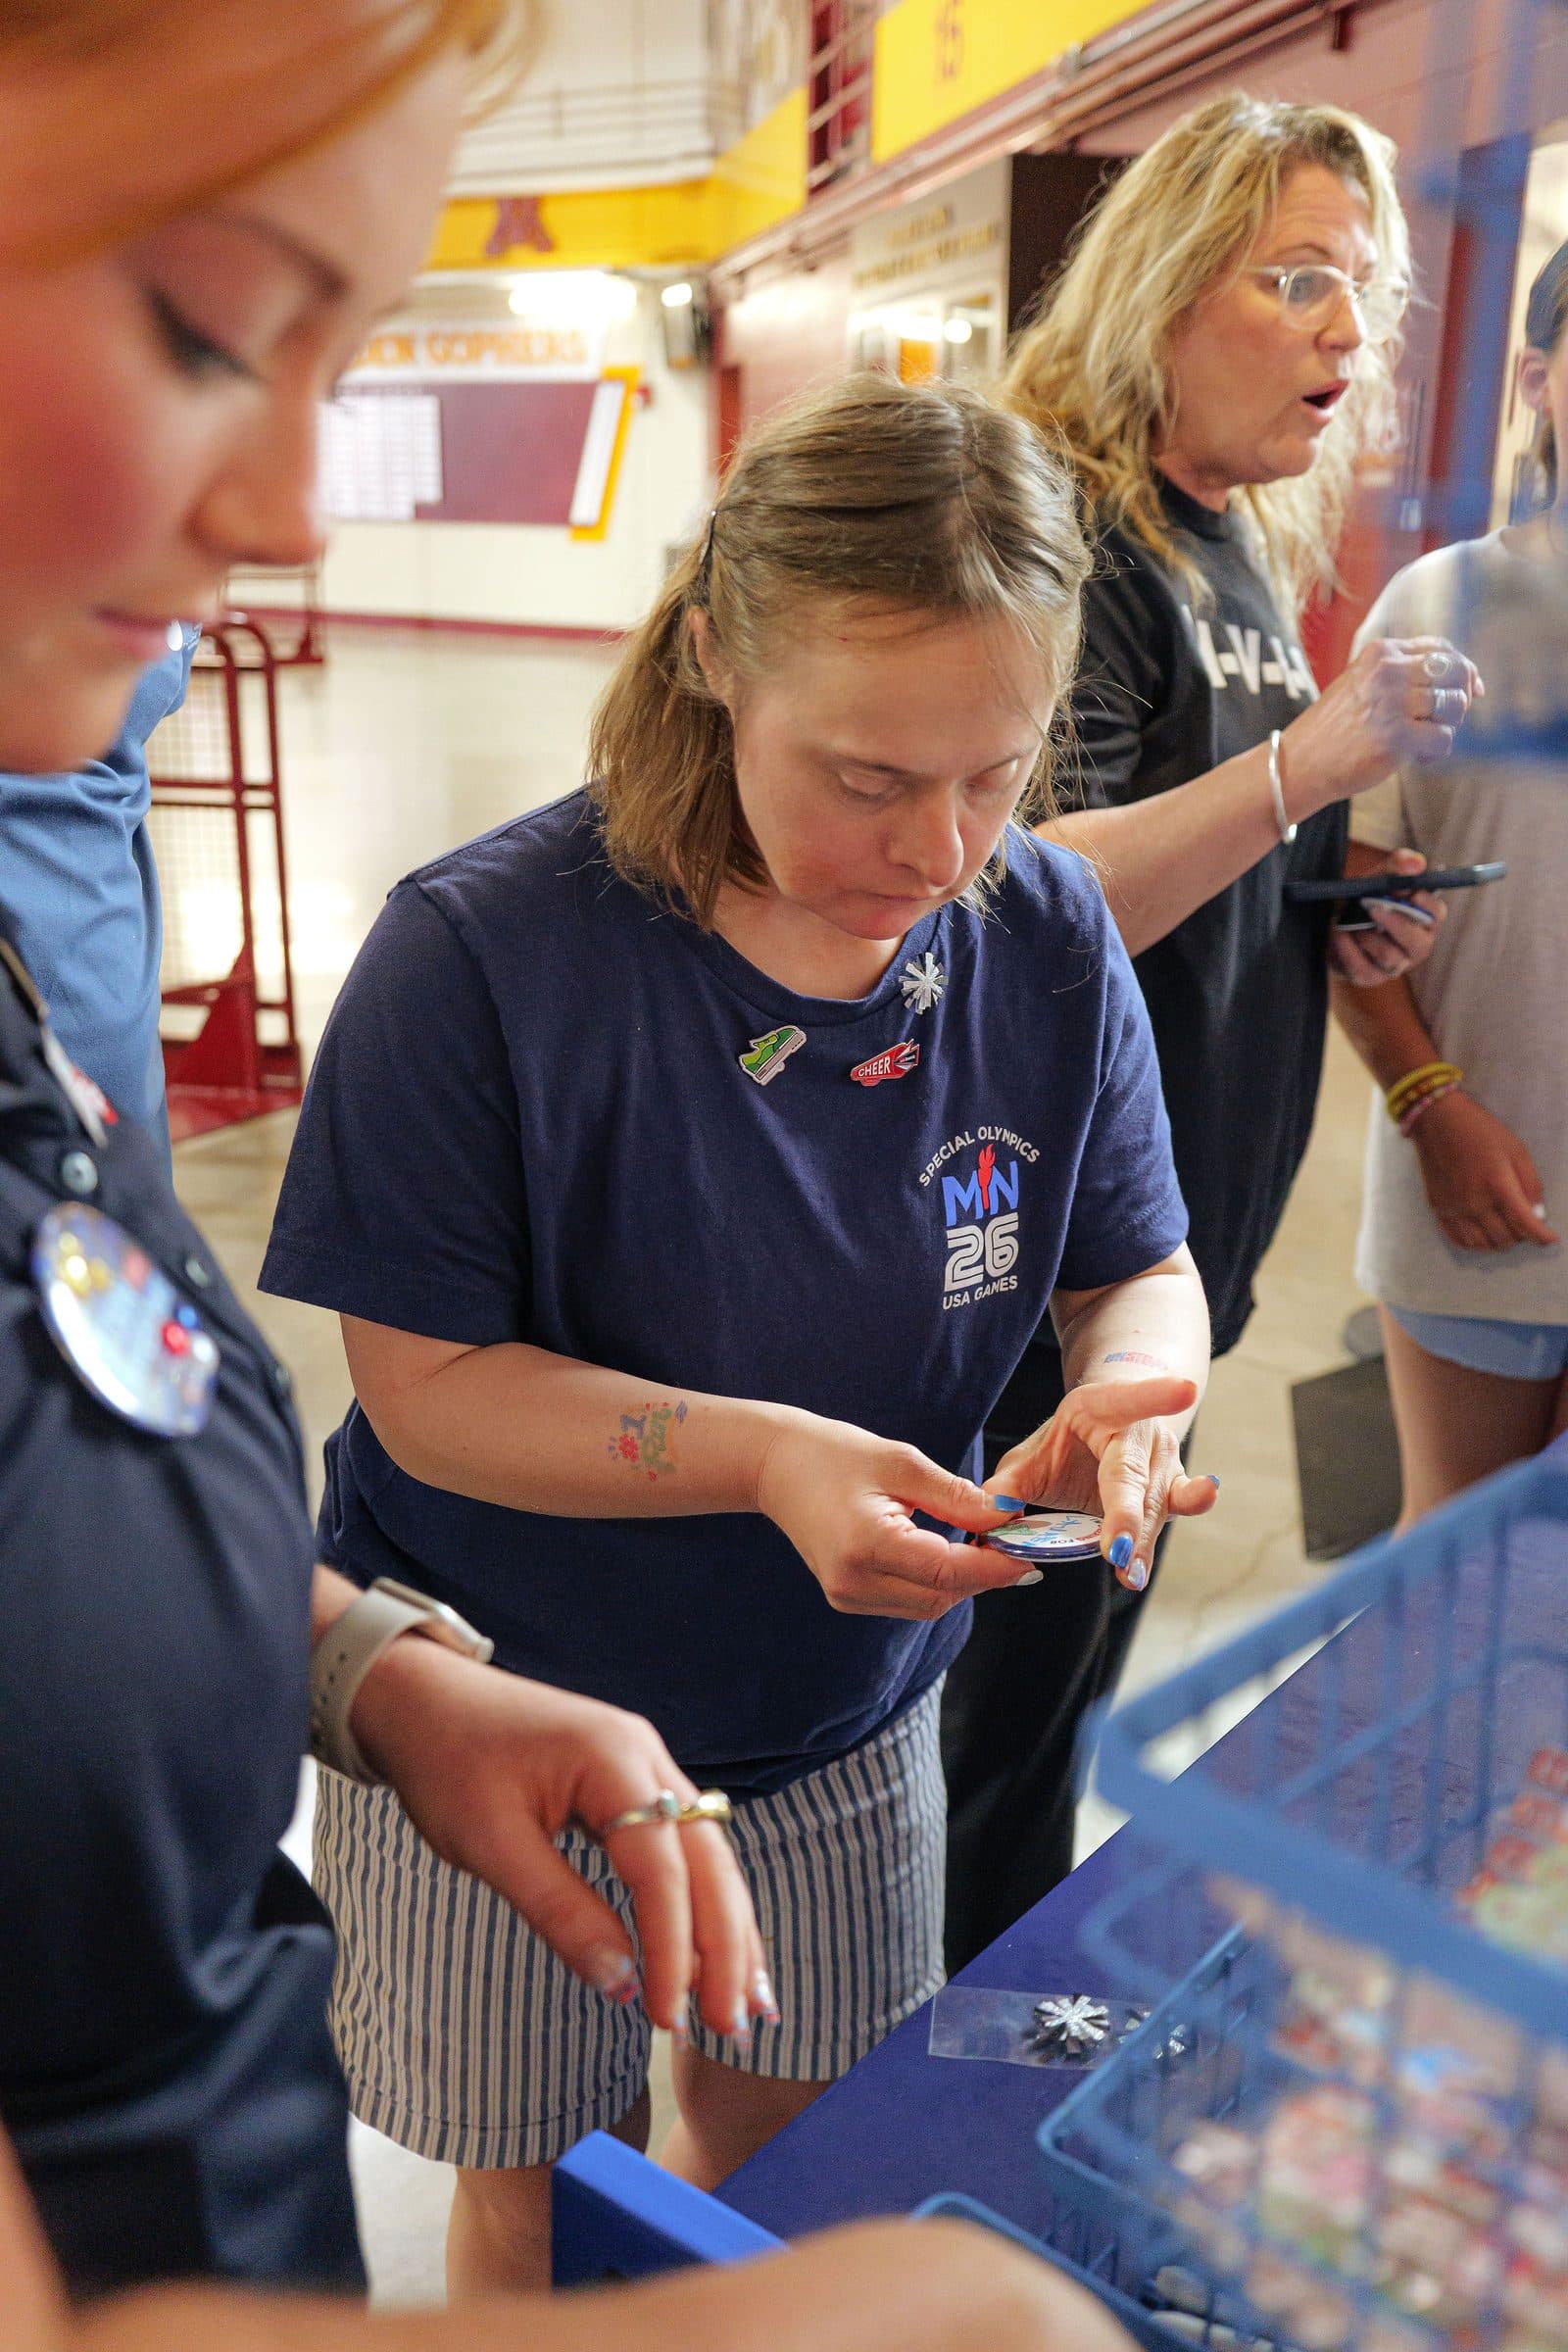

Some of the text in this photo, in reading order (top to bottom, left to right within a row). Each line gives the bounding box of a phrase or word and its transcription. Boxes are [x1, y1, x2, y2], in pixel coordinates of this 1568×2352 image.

[858, 1055, 891, 1077] CHEER
[919, 1126, 1040, 1187] SPECIAL OLYMPICS
[941, 1160, 1019, 1227] MN
[944, 1211, 1019, 1293] 26
[942, 1275, 1018, 1310] USA GAMES
